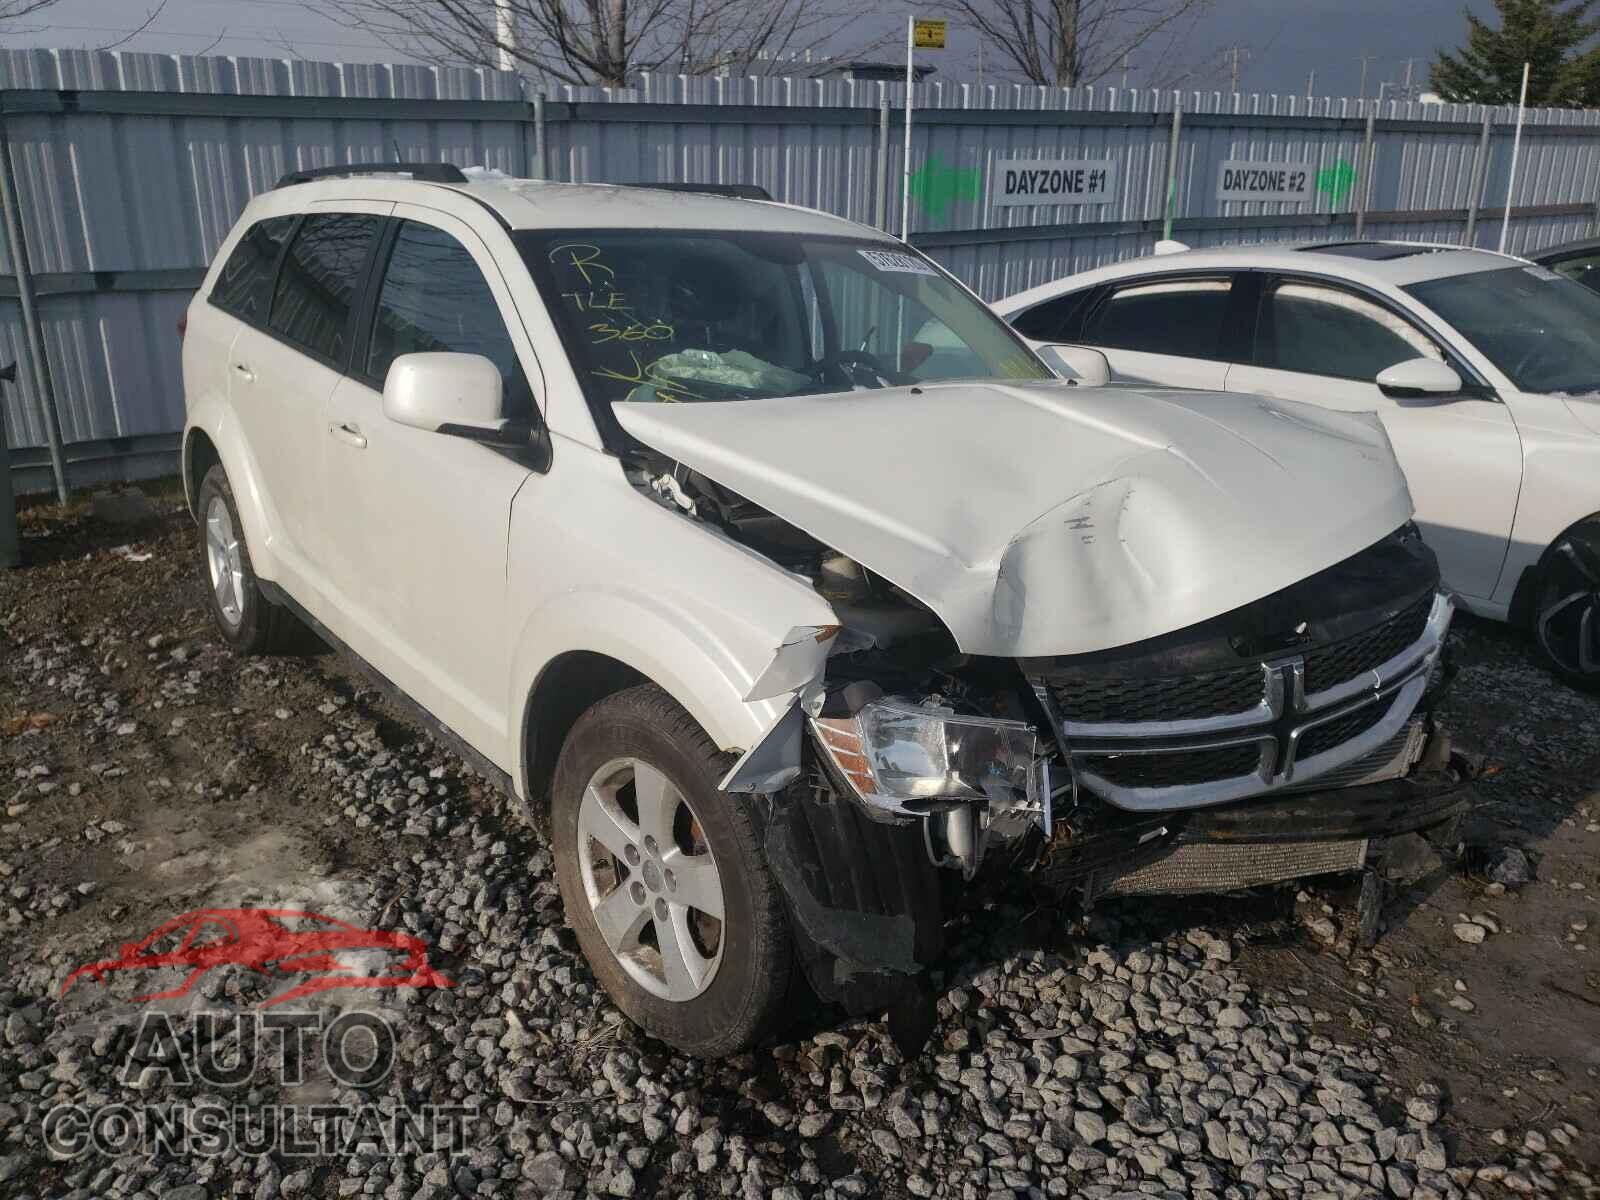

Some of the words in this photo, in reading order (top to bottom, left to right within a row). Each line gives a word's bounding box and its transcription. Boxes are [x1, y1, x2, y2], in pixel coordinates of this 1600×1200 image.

[1005, 168, 1085, 195] DAYZONE
[1088, 169, 1107, 193] #1
[1223, 168, 1286, 192] DAYZONE
[1287, 170, 1306, 193] #2
